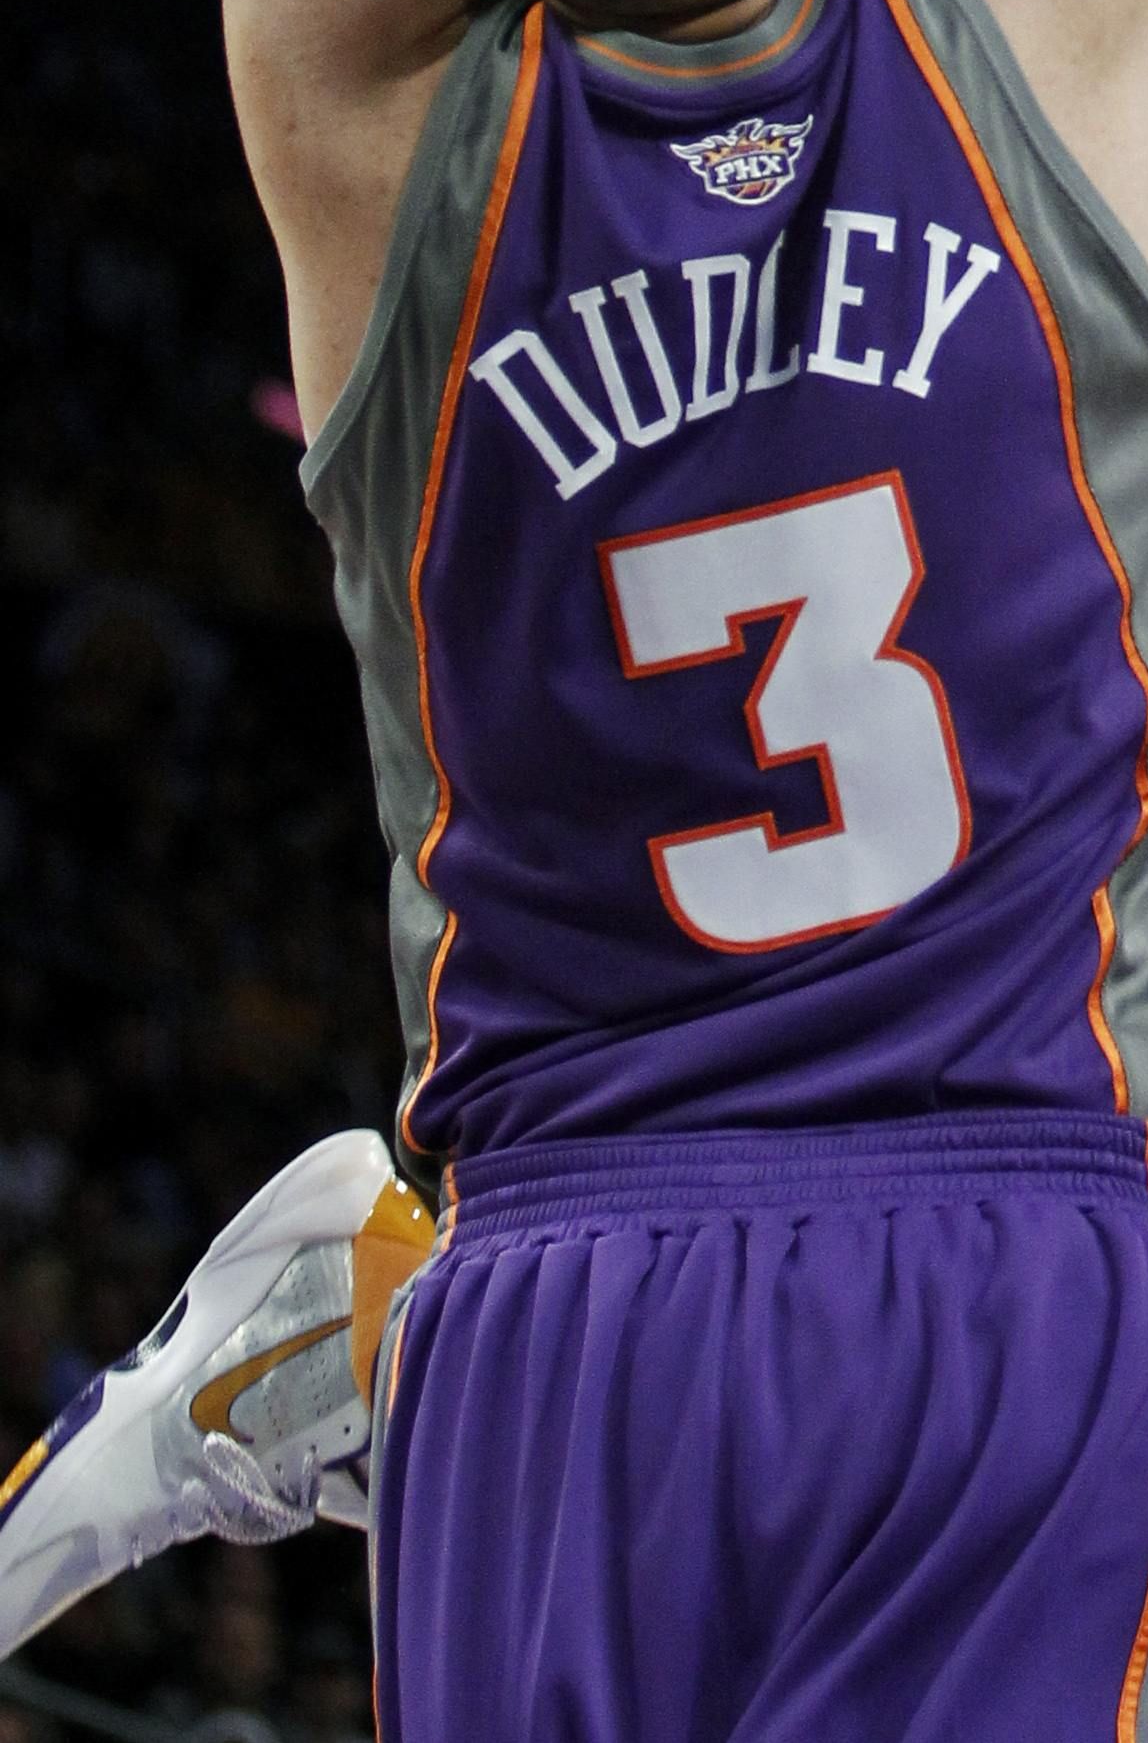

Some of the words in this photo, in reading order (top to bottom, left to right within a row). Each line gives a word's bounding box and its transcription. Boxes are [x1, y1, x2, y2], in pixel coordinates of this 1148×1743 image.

[714, 156, 784, 184] PHX
[468, 209, 1001, 501] DUDLEY
[597, 468, 973, 955] 3
